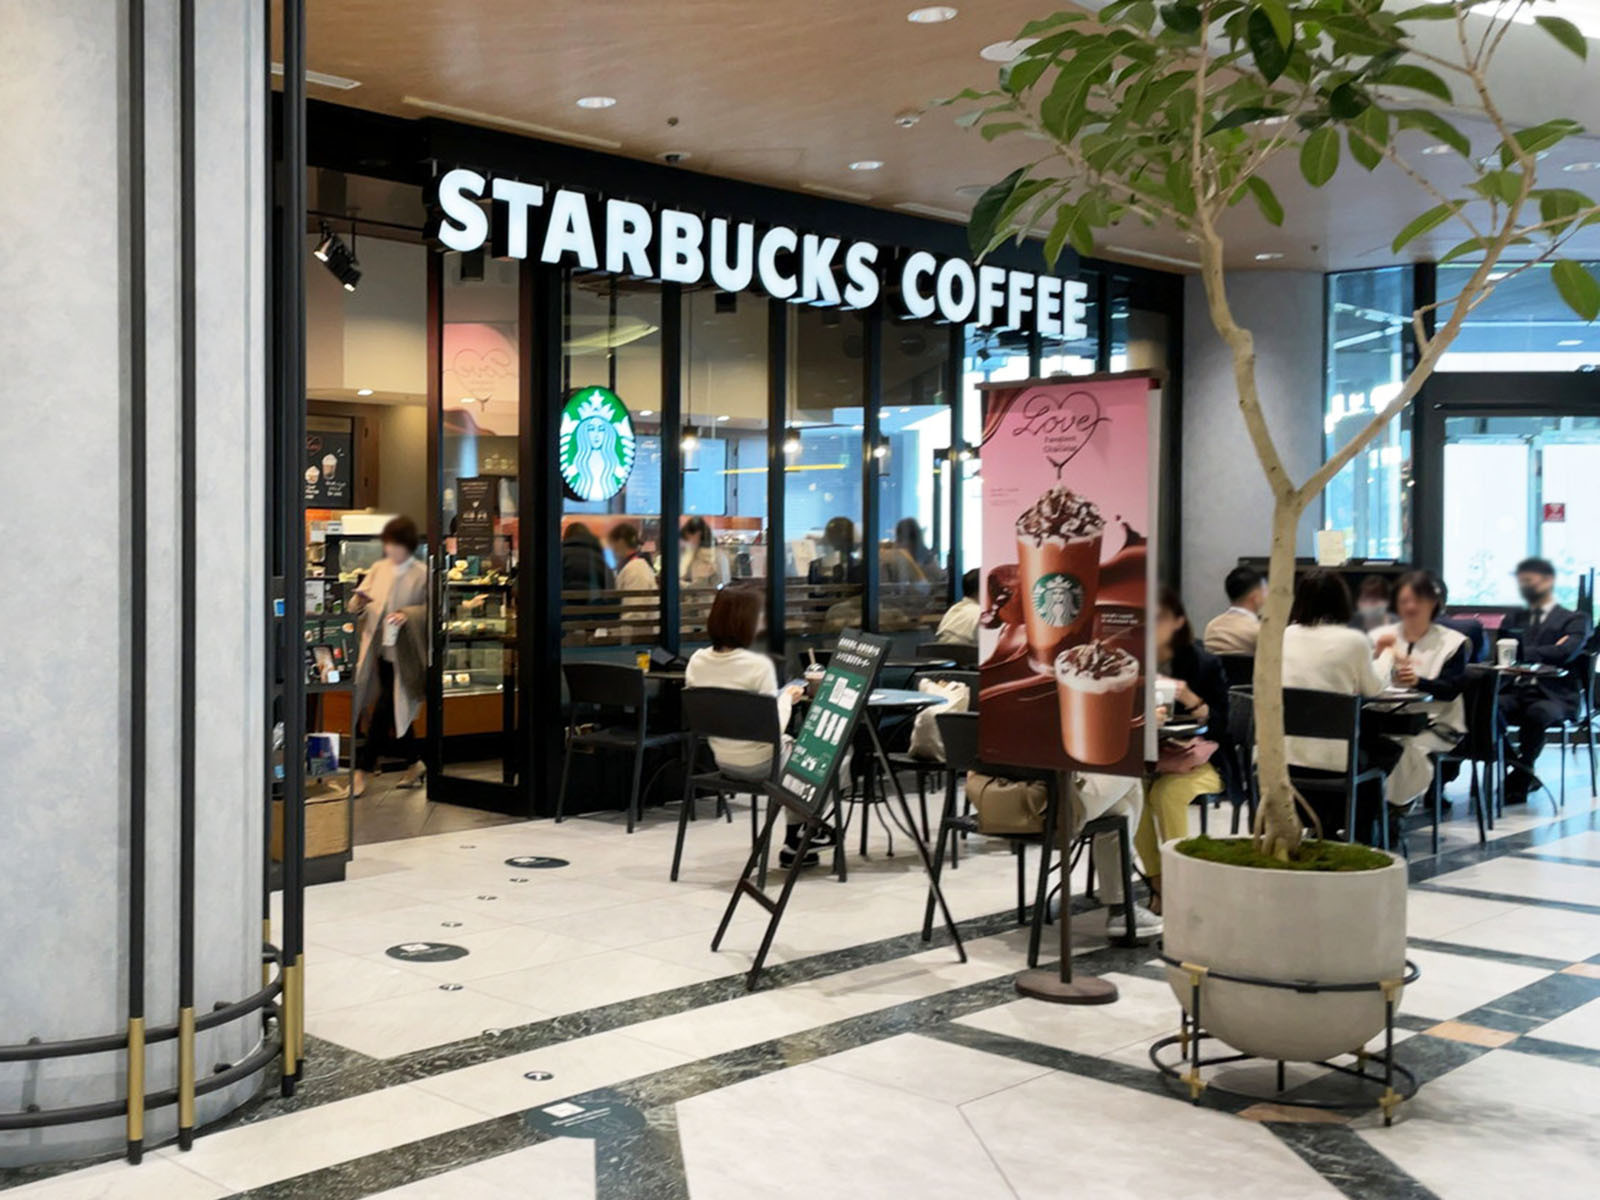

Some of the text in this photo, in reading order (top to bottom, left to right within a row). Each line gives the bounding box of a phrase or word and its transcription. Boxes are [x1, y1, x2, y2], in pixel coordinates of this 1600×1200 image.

[437, 168, 1088, 341] STARBUCKS COFFEE
[1013, 402, 1108, 436] Love
